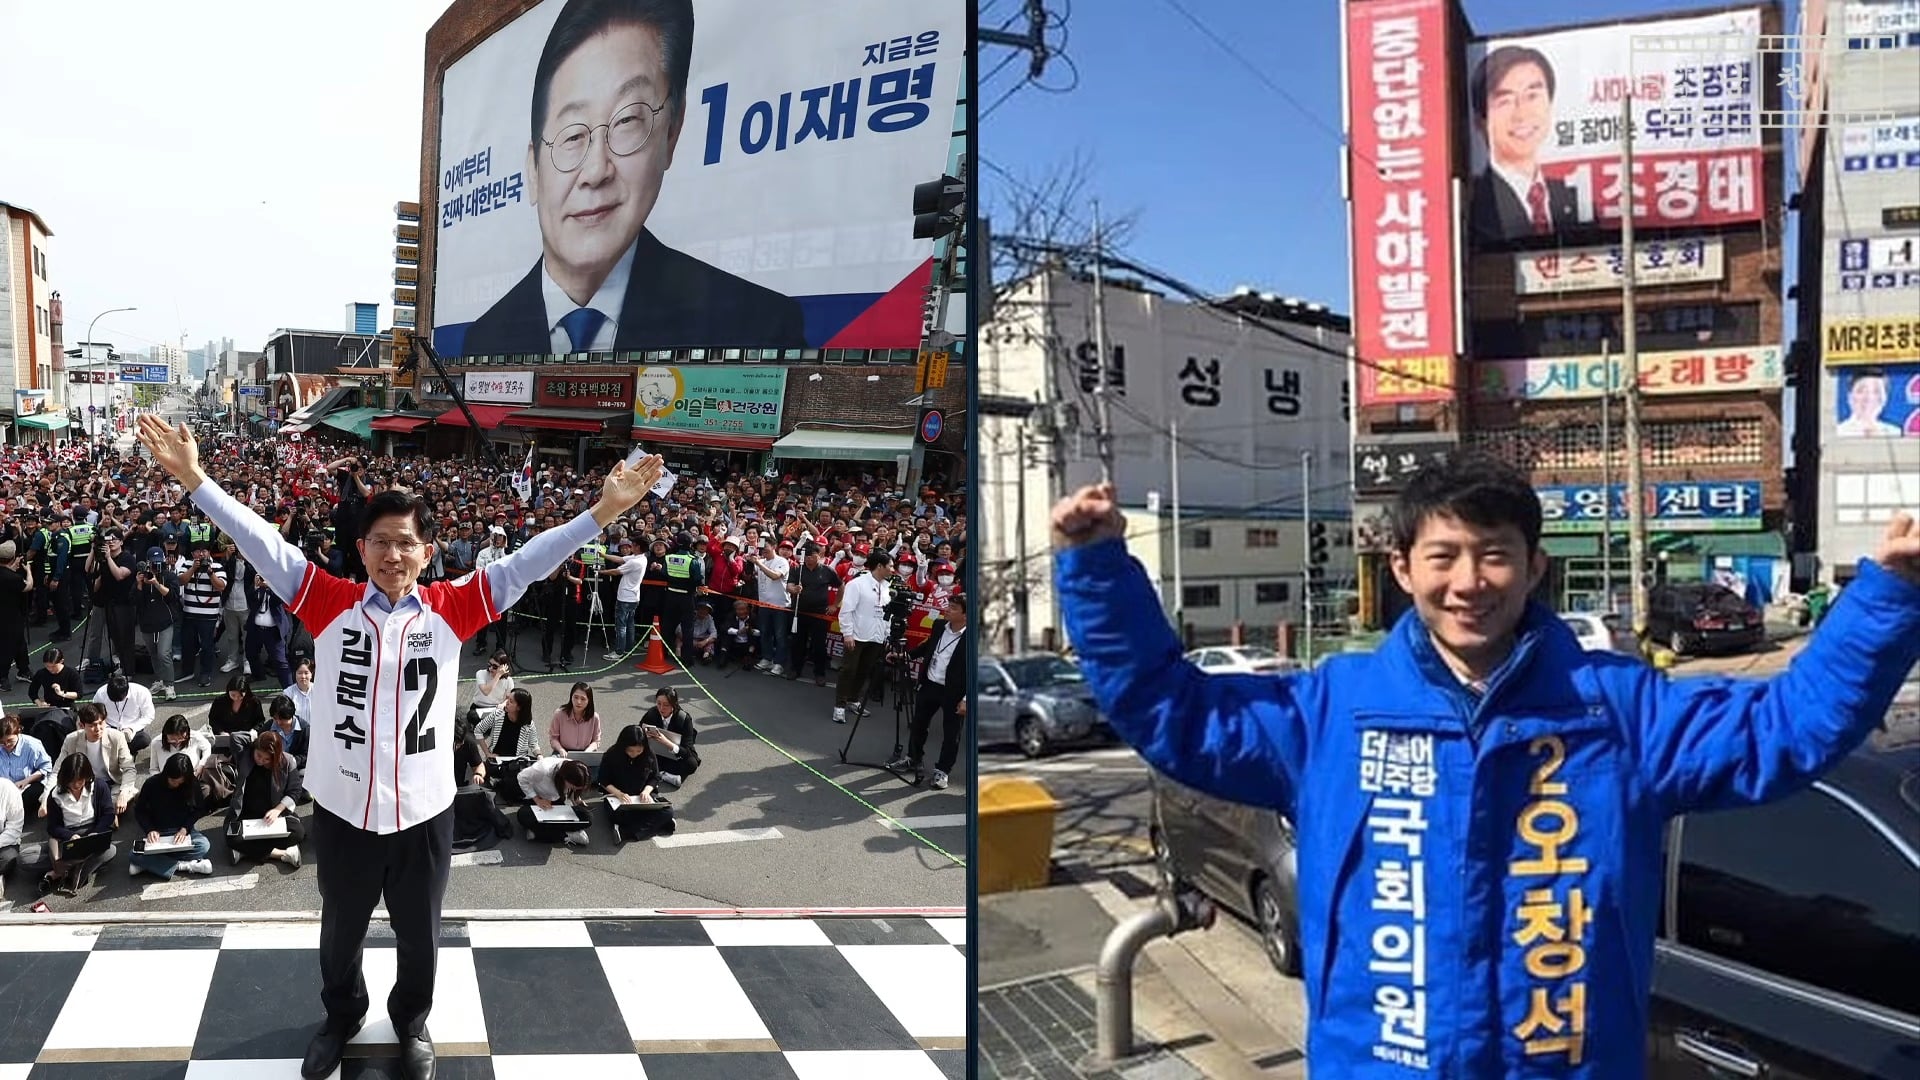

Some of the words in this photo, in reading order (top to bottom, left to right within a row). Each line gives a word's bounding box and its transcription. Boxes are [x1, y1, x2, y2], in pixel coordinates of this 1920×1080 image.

[863, 30, 940, 67] 지금은
[702, 81, 729, 165] 1
[740, 63, 936, 155] 이재명
[1372, 17, 1425, 182] 중단없는
[1556, 120, 1574, 146] 일
[443, 146, 492, 191] 이제부터
[442, 201, 463, 229] 진짜
[464, 172, 524, 217] 대한민국
[1375, 190, 1431, 349] 사하발전
[569, 382, 622, 398] 정육백화점
[732, 401, 778, 415] 건강원
[408, 631, 432, 640] PEOPLE
[408, 639, 432, 648] POWER
[334, 627, 372, 750] 김문수
[404, 657, 438, 755] 2
[1361, 731, 1433, 764] 더불어
[1360, 759, 1438, 796] 민주당
[1367, 798, 1428, 1049] 국회의원
